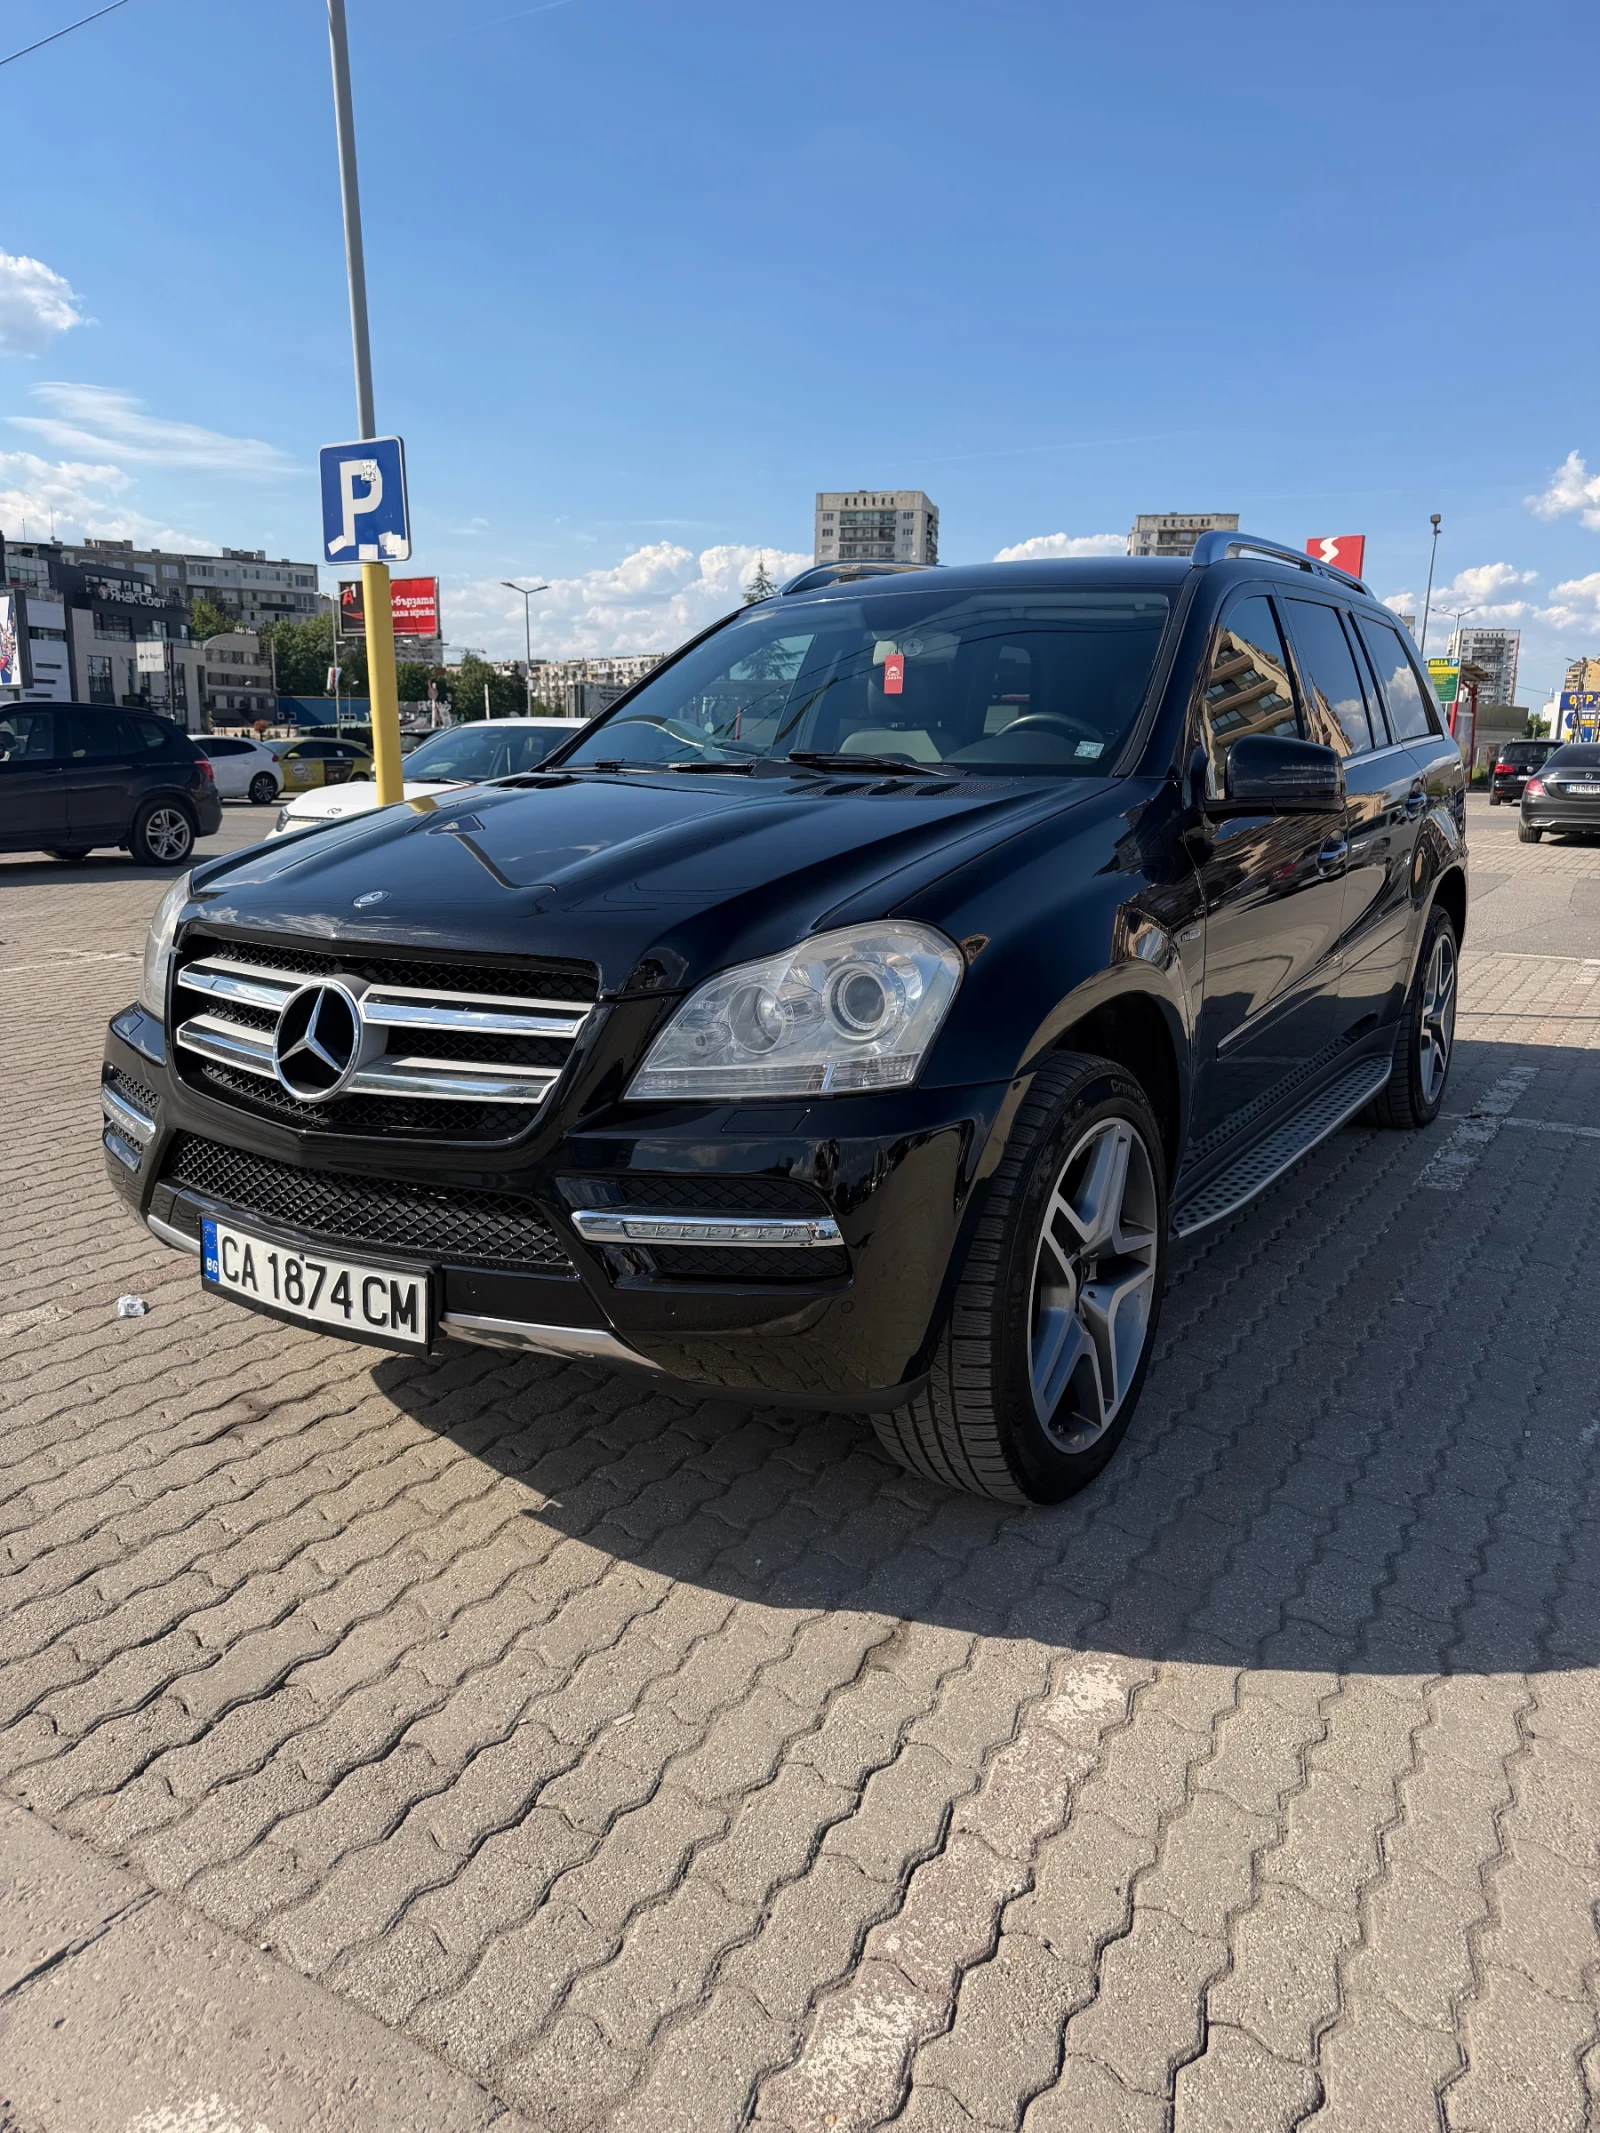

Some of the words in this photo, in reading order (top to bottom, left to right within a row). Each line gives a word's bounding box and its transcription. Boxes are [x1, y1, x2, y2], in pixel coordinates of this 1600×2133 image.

[339, 459, 382, 546] P
[206, 1257, 219, 1274] BG
[221, 1235, 259, 1292] CA
[267, 1252, 353, 1319] 1874
[362, 1275, 419, 1334] CM
